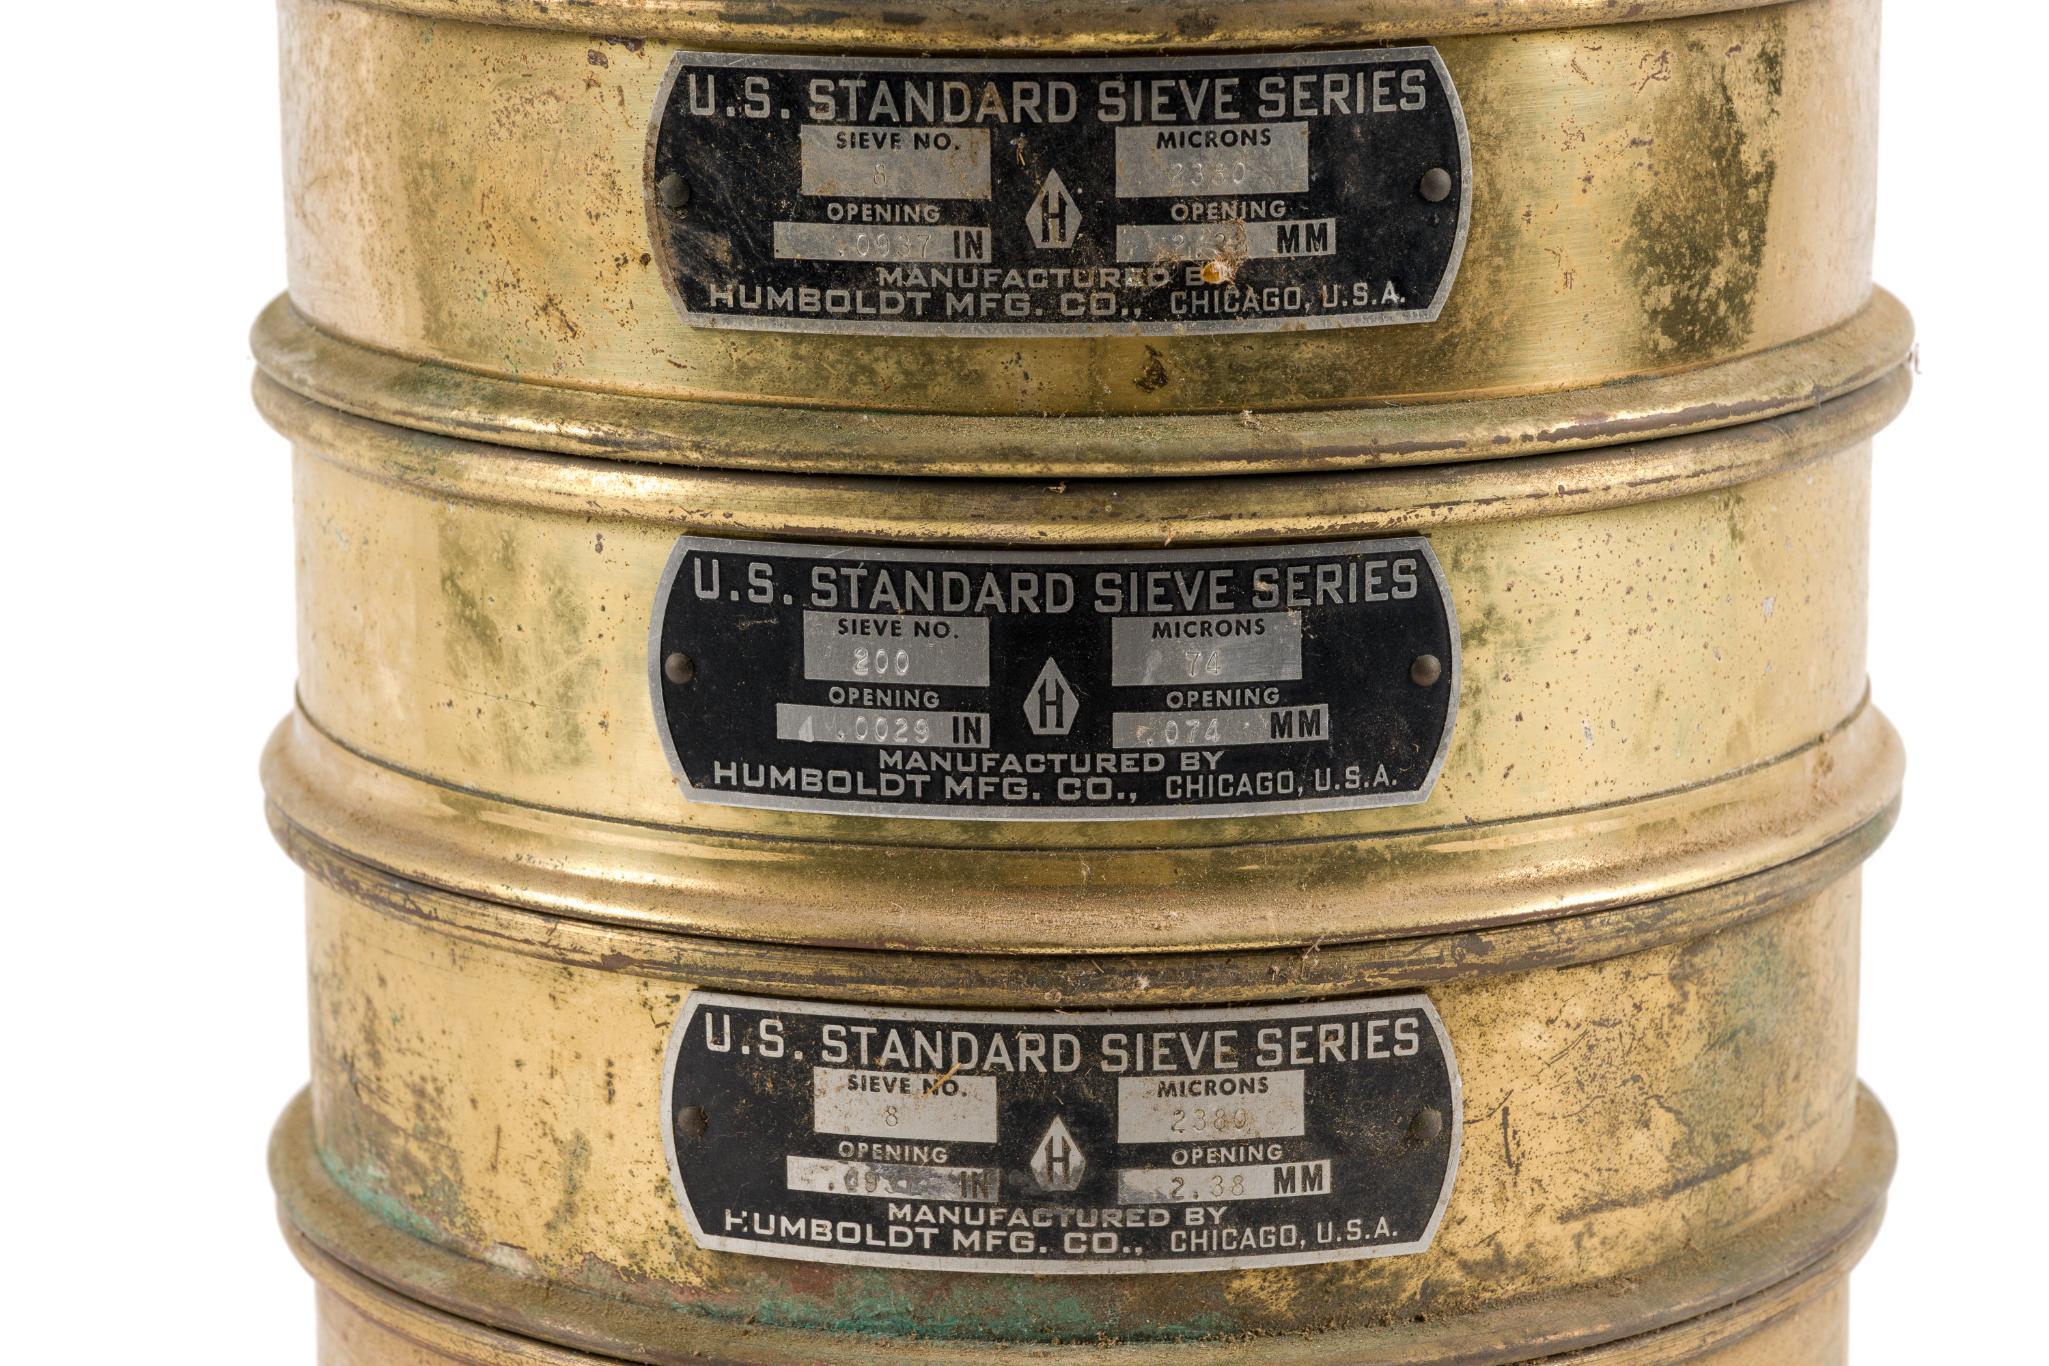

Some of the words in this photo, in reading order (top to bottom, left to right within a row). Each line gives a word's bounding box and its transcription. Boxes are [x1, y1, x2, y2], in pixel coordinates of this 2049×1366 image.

[688, 73, 790, 120] U.S.
[809, 78, 1077, 124] STANDARD
[1098, 78, 1240, 122] SIEVE
[1258, 69, 1426, 118] SERIES
[836, 131, 901, 149] SIEVE
[914, 132, 960, 151] NO.
[1157, 128, 1272, 149] MICRONS
[873, 162, 887, 185] 8
[827, 203, 940, 223] OPENING
[1171, 200, 1287, 221] OPENING
[953, 230, 983, 259] IN
[1277, 223, 1328, 254] MM
[879, 266, 1169, 288] MANUFACTURED
[1186, 266, 1226, 287] B
[710, 284, 932, 313] HUMBOLDT
[946, 292, 1043, 317] MFG.
[1058, 292, 1141, 318] CO.,
[1171, 287, 1310, 314] CHICAGO,
[1322, 281, 1405, 307] U.S.A.
[694, 558, 793, 605] U.S.
[811, 565, 1073, 613] STANDARD
[1095, 569, 1234, 612] SIEVE
[1253, 558, 1417, 608] SERIES
[838, 618, 902, 637] SIEVE
[914, 621, 959, 639] NO.
[1152, 618, 1265, 639] MICRONS
[853, 647, 910, 676] 200
[1185, 650, 1221, 677] 74
[829, 686, 940, 708] OPENING
[1166, 687, 1280, 709] OPENING
[837, 716, 929, 744] .0029
[952, 716, 982, 744] IN
[1147, 718, 1220, 746] .074
[1270, 709, 1321, 740] MM
[880, 749, 1165, 773] MANUFACTURED
[1181, 750, 1224, 771] BY
[715, 760, 932, 798] HUMBOLDT
[945, 776, 1041, 800] MFG.
[1057, 778, 1137, 803] CO.,
[1166, 771, 1304, 799] CHICAGO,
[1315, 764, 1397, 792] U.S.A.
[705, 1012, 803, 1060] U.S.
[821, 1023, 1081, 1072] STANDARD
[1100, 1030, 1238, 1073] SIEVE
[1257, 1017, 1420, 1067] SERIES
[847, 1074, 911, 1094] SIEVE
[922, 1078, 968, 1097] NO.
[1157, 1076, 1269, 1097] MICRONS
[885, 1105, 898, 1127] 8
[1171, 1108, 1247, 1133] 2380
[839, 1140, 948, 1163] OPENING
[1171, 1144, 1282, 1166] OPENING
[960, 1170, 989, 1199] IN
[1170, 1175, 1245, 1200] 2.38
[1273, 1164, 1323, 1194] MM
[887, 1203, 1169, 1228] MANUFACTURED
[1185, 1206, 1230, 1226] BY
[725, 1208, 940, 1249] HUMBOLDT
[953, 1230, 1047, 1254] MFG.
[1064, 1232, 1142, 1256] CO.,
[1171, 1224, 1306, 1252] CHICAGO,
[1317, 1216, 1398, 1244] U.S.A.
